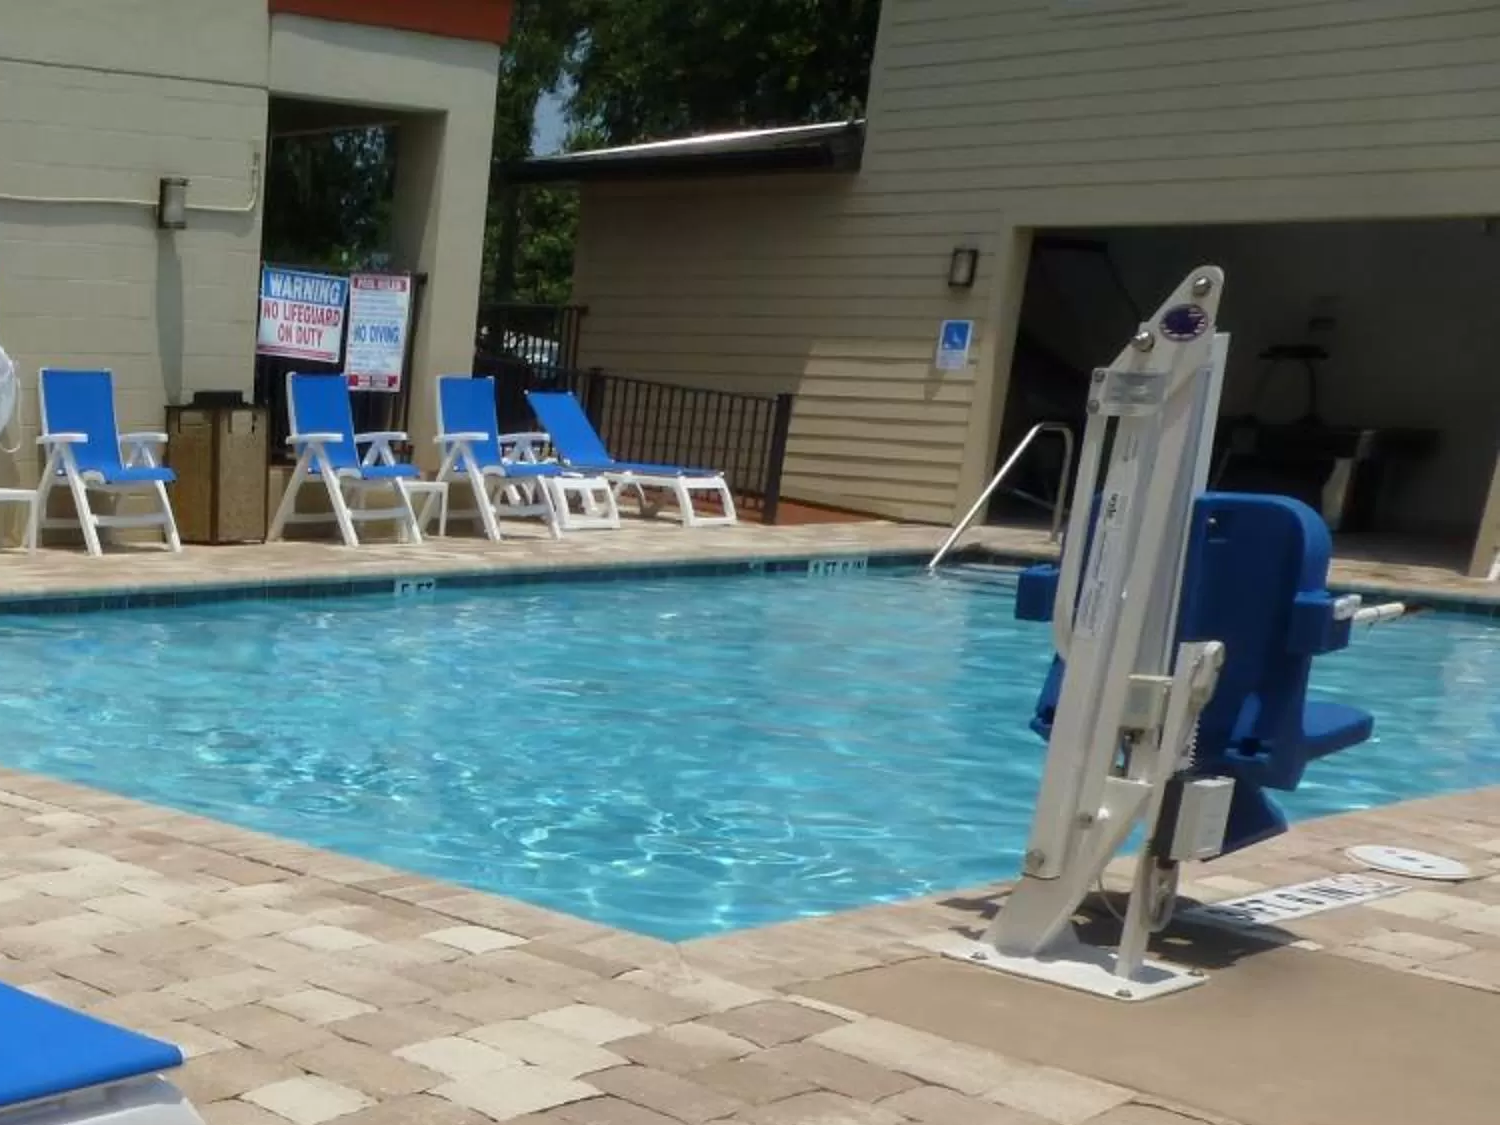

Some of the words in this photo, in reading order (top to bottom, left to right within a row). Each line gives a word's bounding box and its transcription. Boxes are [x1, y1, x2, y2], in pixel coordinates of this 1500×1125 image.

[270, 273, 341, 302] WARNING
[263, 301, 279, 319] NO
[283, 303, 341, 327] LIFEGUARD
[277, 323, 293, 342] ON
[298, 325, 324, 347] DUTY
[354, 325, 367, 342] NO
[369, 325, 399, 344] DIVING
